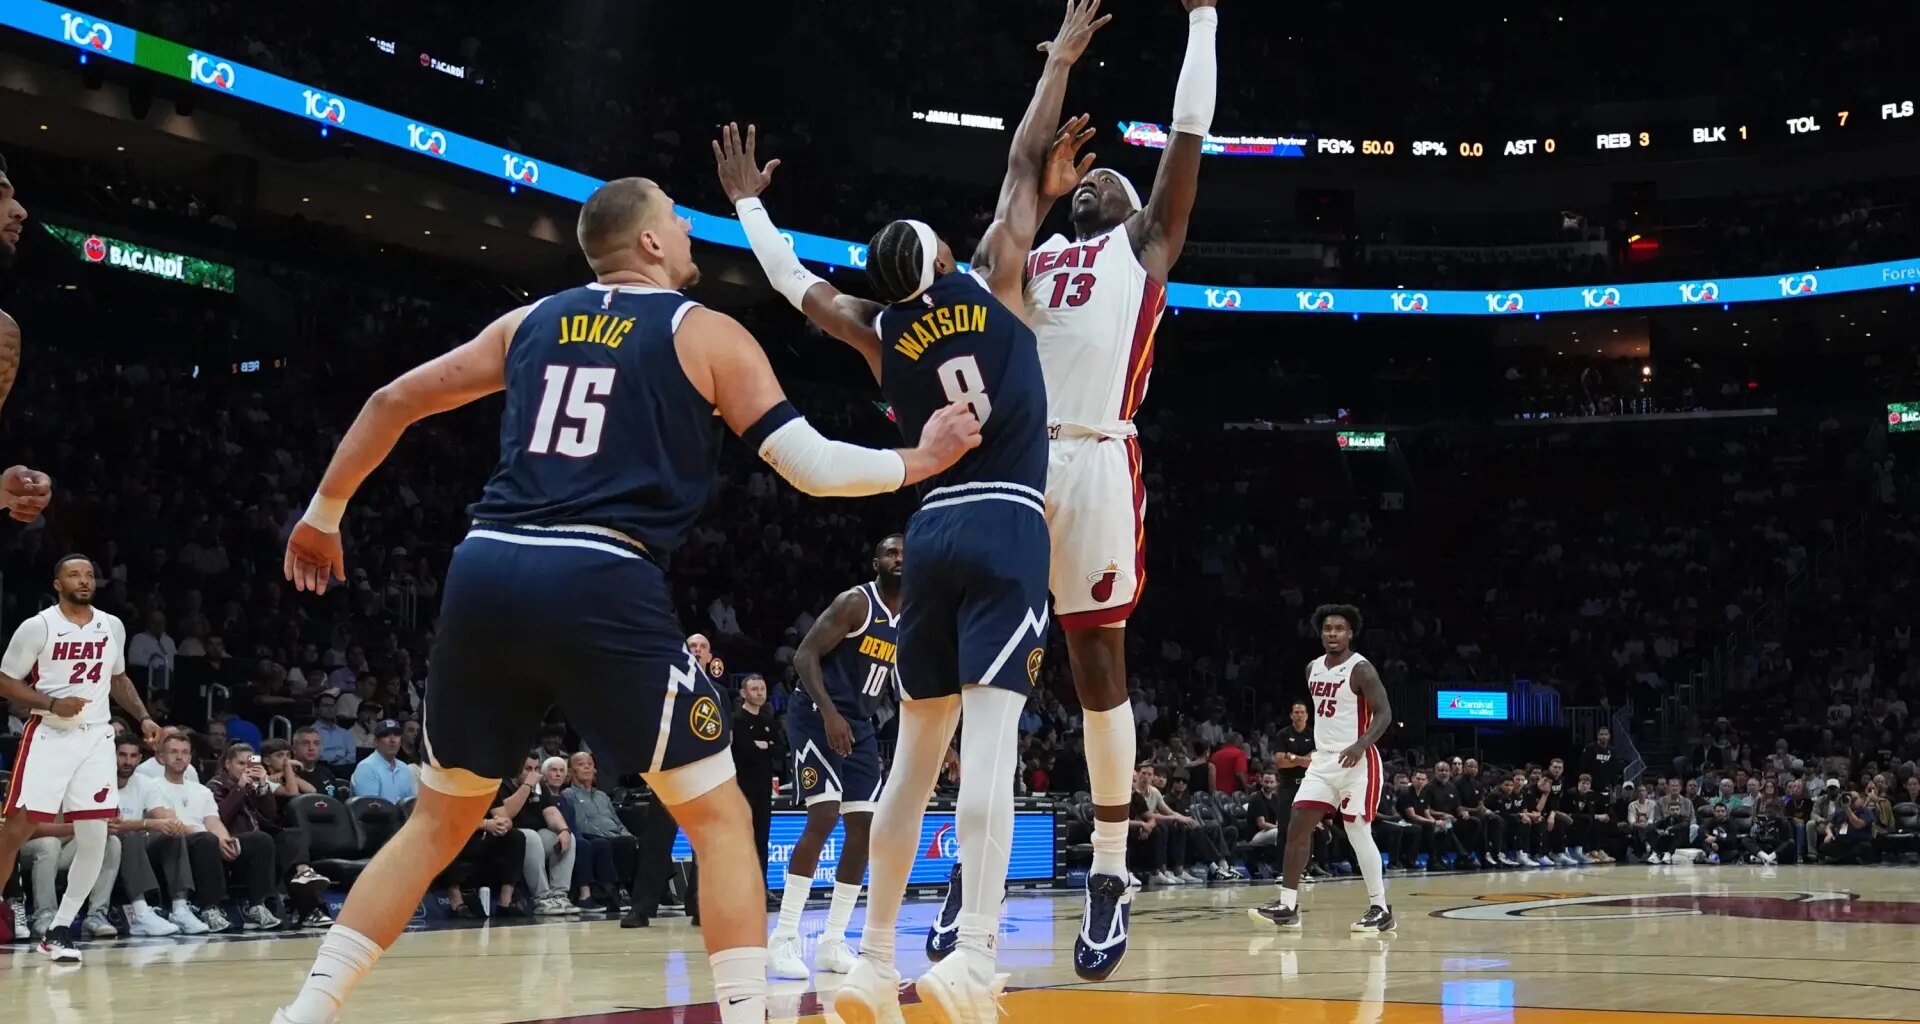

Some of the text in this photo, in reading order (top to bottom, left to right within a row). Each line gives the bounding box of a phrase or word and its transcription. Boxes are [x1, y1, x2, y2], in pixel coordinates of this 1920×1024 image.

[61, 13, 112, 50] 100
[188, 53, 235, 89] 100
[303, 90, 345, 123] 100
[407, 124, 446, 155] 100
[1241, 136, 1277, 145] Solutions
[1278, 137, 1307, 146] Partner
[1318, 101, 1914, 156] FG% 50.0 3P% 0.0 AST 0 REB 3 BLK 1 TOL 7 FLS
[502, 154, 538, 184] 100
[110, 246, 184, 279] BACARDÍ
[1049, 273, 1096, 308] 13
[1204, 288, 1241, 309] 100
[1582, 287, 1620, 307] 100
[1679, 282, 1719, 303] 100
[1778, 274, 1817, 296] 100
[1296, 291, 1334, 311] 100
[1390, 292, 1428, 312] 100
[1486, 292, 1523, 312] 100
[559, 315, 636, 348] JOKIĆ
[894, 304, 987, 361] WATSON
[937, 355, 992, 428] 8
[528, 365, 616, 458] 15
[1902, 412, 1920, 422] BAC
[52, 636, 108, 660] HEAT
[69, 662, 103, 684] 24
[862, 663, 888, 697] 10
[1309, 679, 1345, 697] HEAT
[1317, 699, 1337, 717] 45
